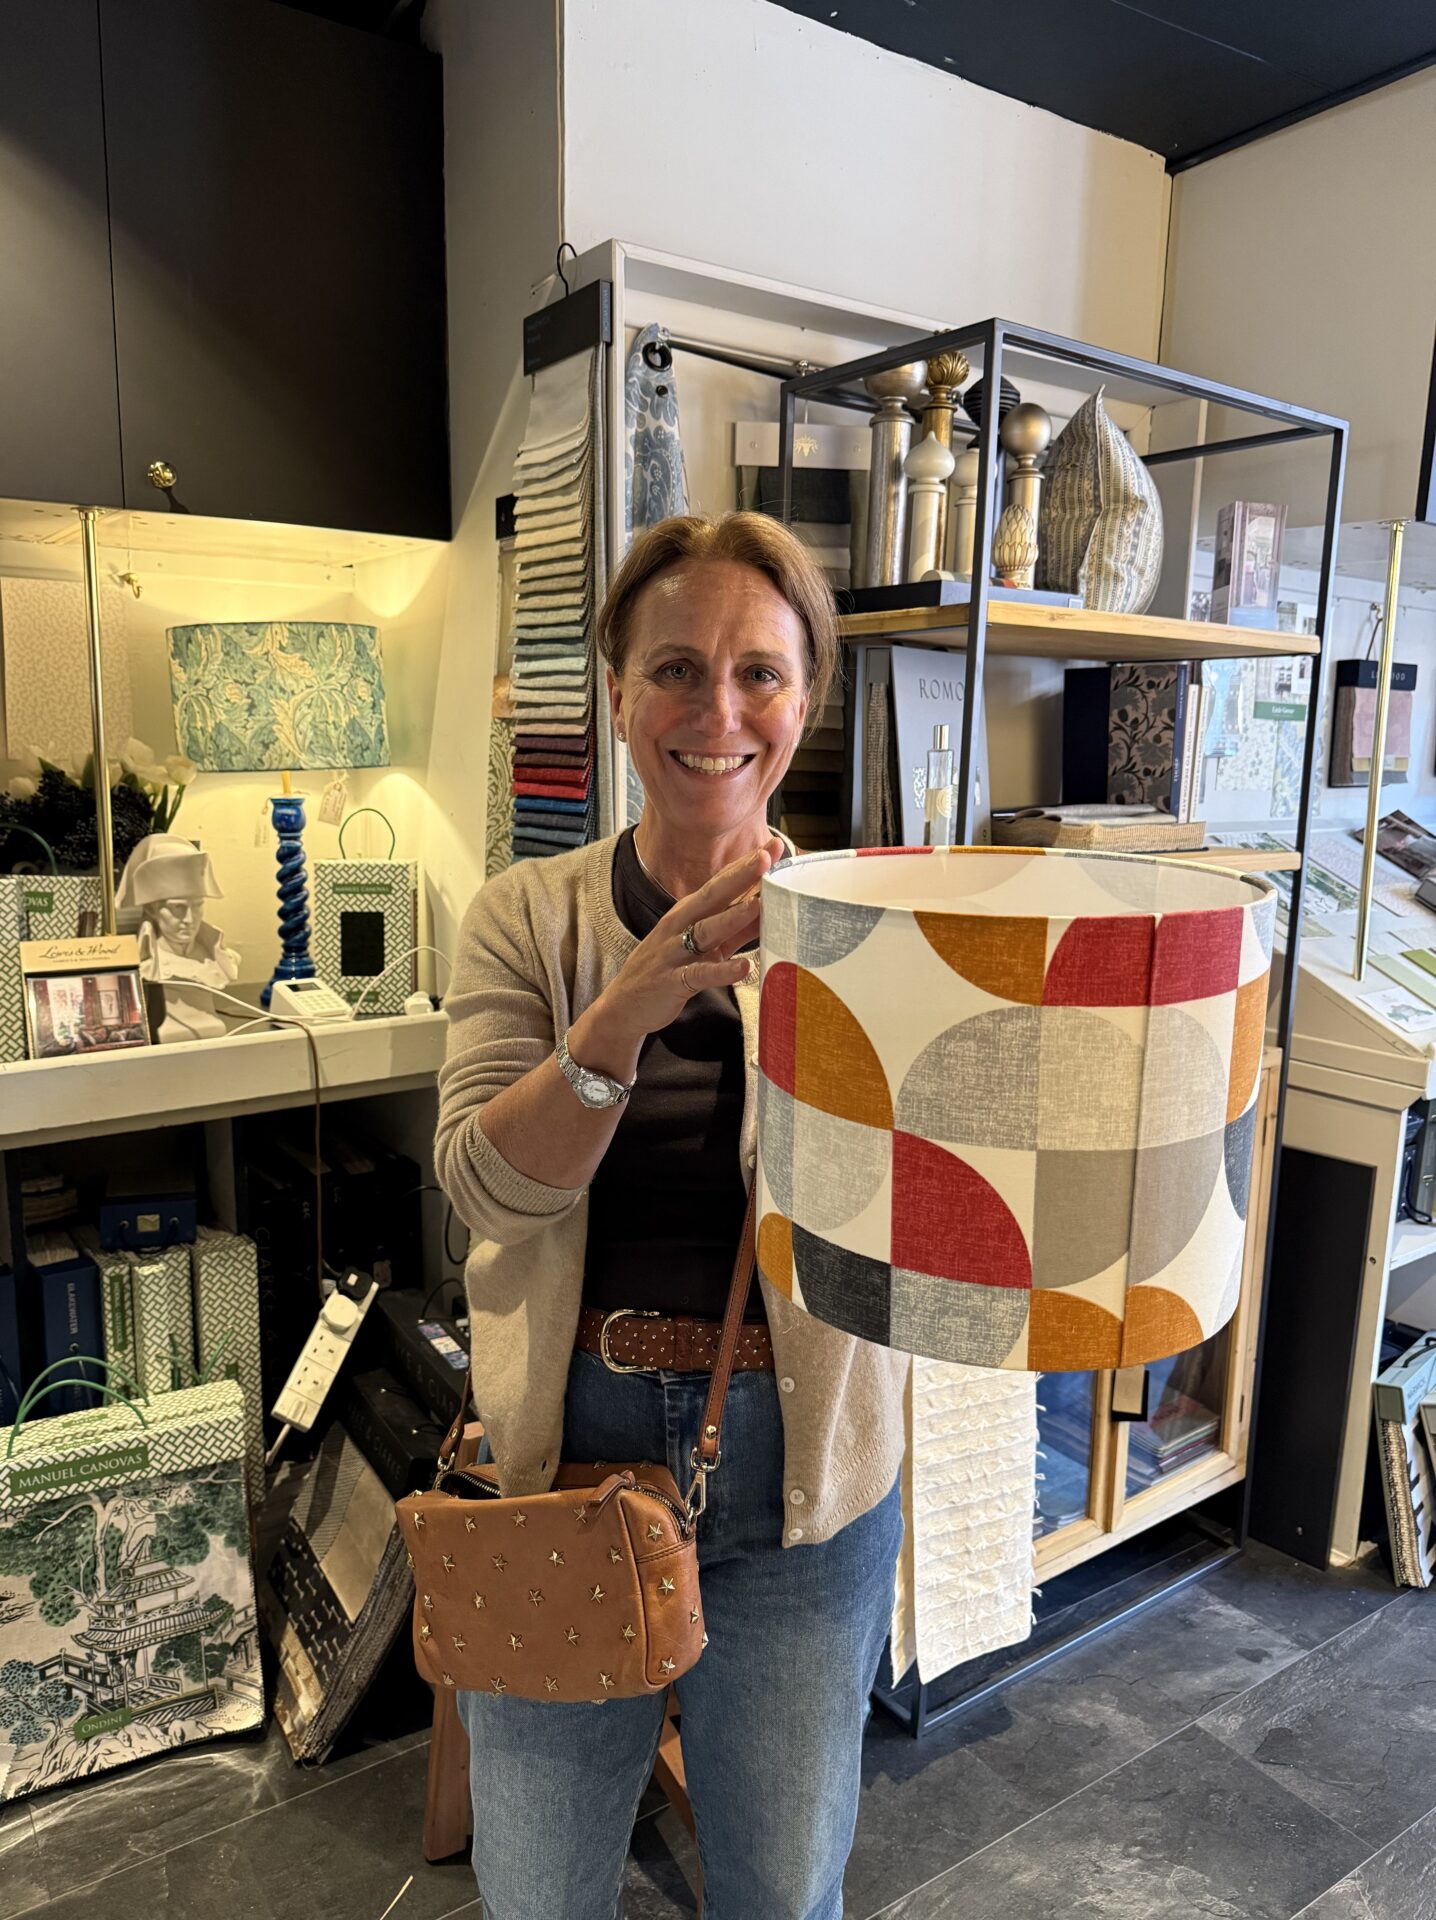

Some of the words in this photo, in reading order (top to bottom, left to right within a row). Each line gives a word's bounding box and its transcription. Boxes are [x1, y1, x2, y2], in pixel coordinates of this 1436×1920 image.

[919, 678, 965, 701] ROMO
[24, 896, 49, 907] OVAS
[87, 943, 121, 955] Wood
[18, 1467, 76, 1489] MANUEL
[79, 1453, 142, 1475] CANOVAS
